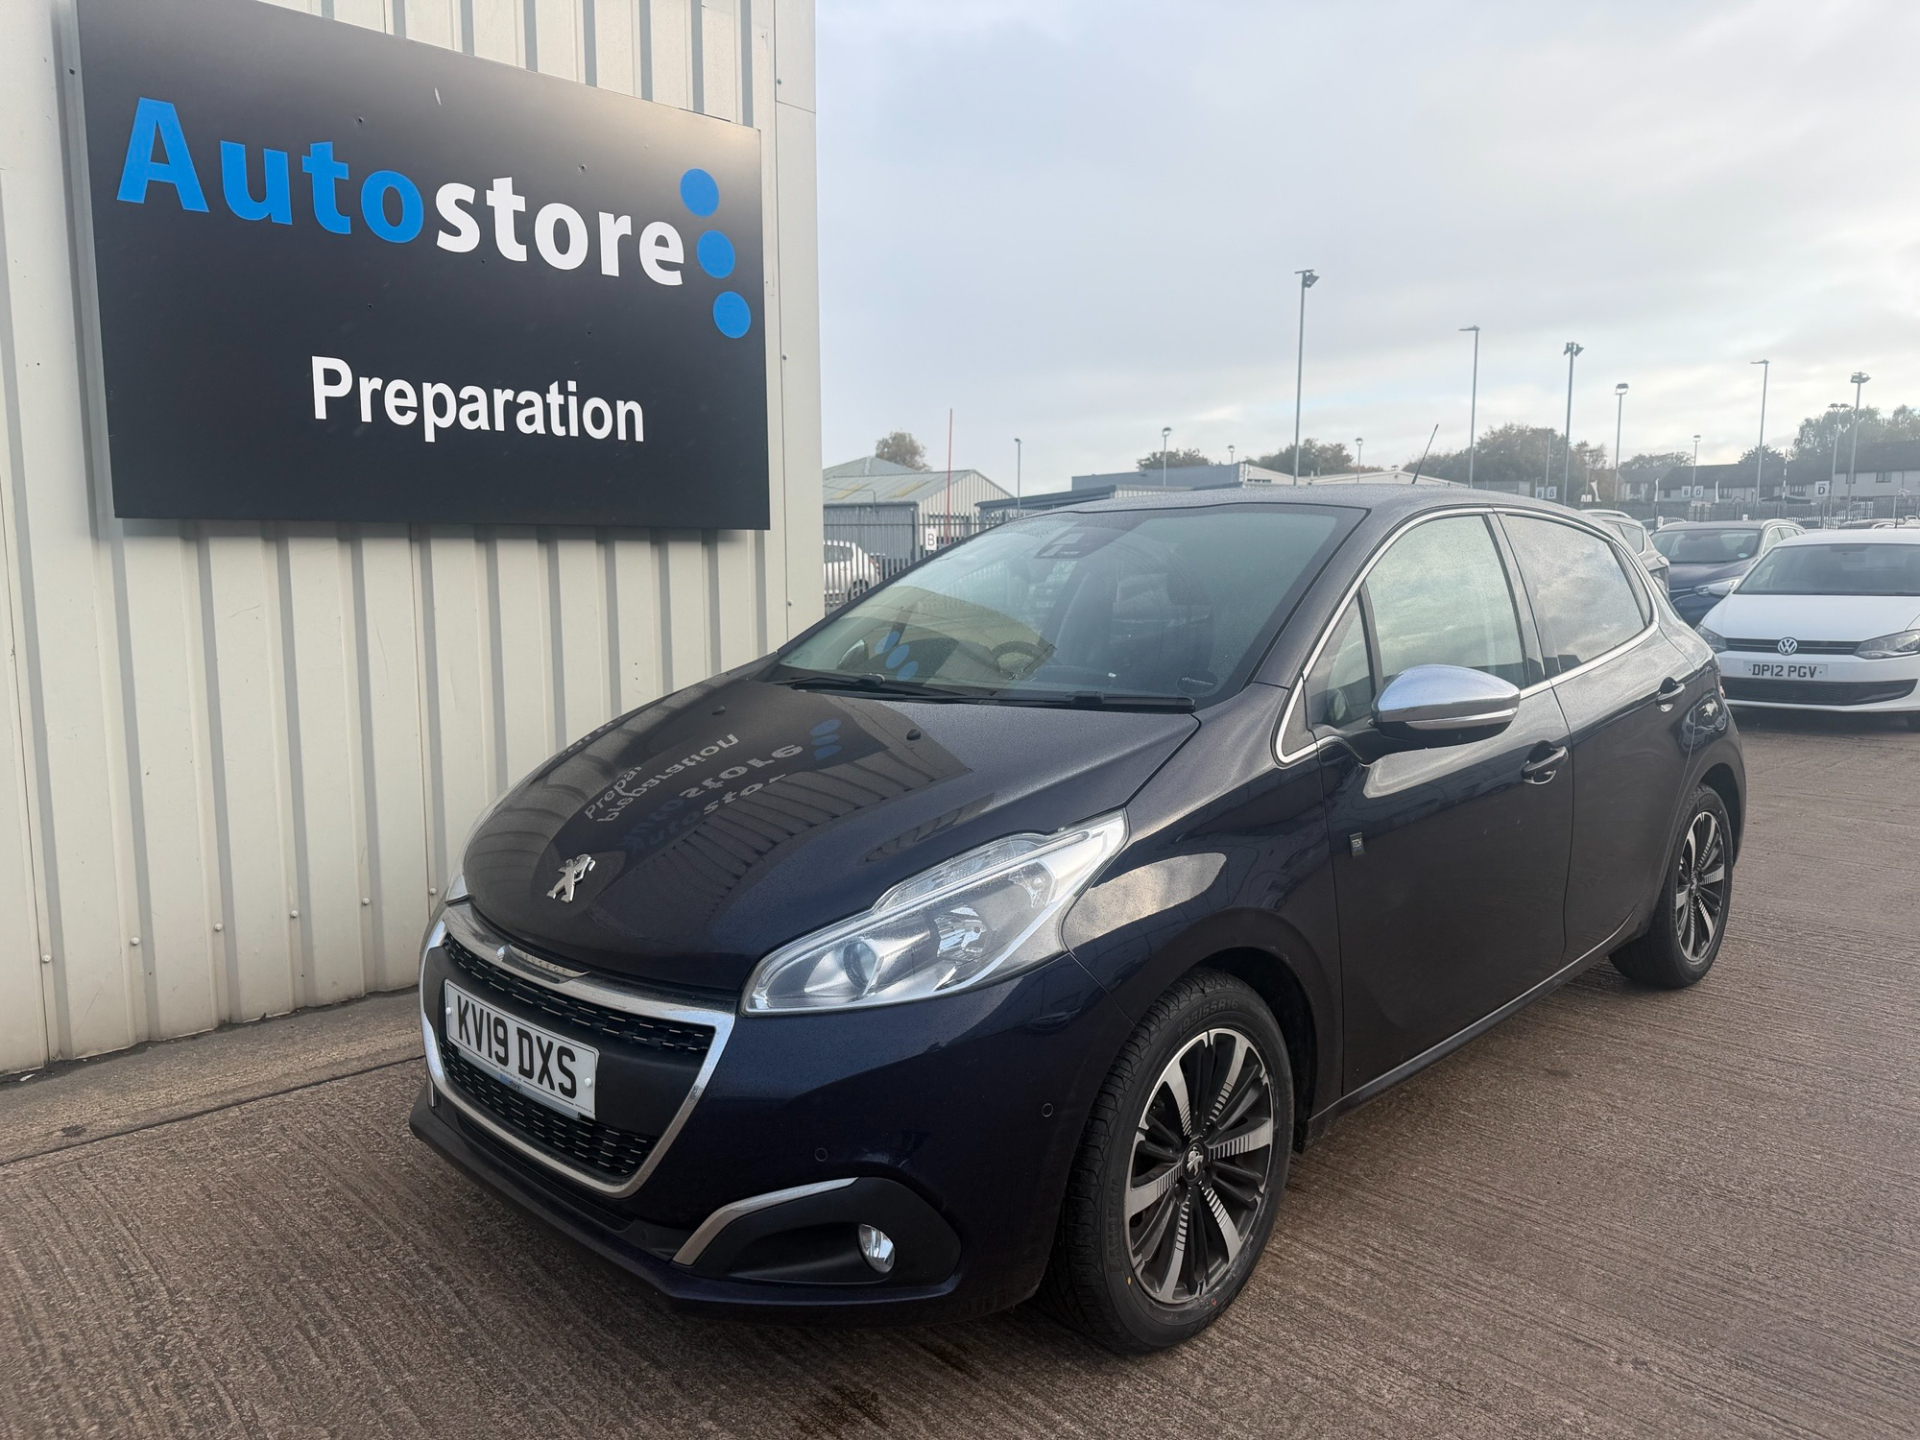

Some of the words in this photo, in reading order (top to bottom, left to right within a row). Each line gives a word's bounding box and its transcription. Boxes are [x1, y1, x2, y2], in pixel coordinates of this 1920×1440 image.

[116, 97, 685, 286] Autostore
[311, 355, 644, 443] Preparation
[1752, 664, 1784, 677] DP12
[1788, 665, 1817, 678] PGV
[457, 995, 509, 1067] KV19
[517, 1026, 577, 1099] DXS
[1178, 999, 1239, 1036] 195/55R16
